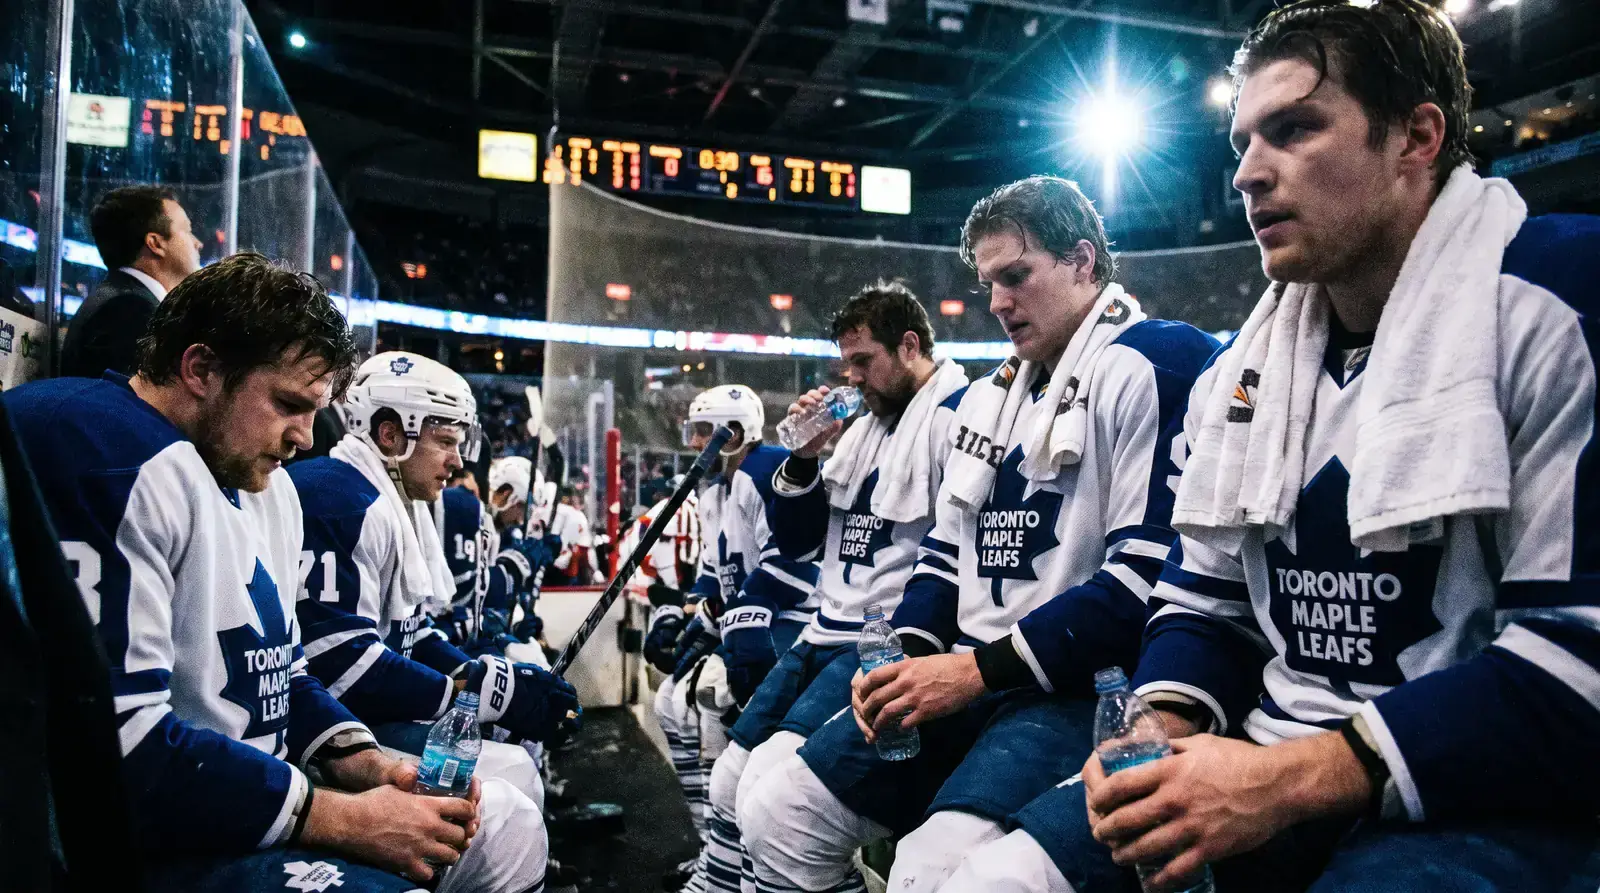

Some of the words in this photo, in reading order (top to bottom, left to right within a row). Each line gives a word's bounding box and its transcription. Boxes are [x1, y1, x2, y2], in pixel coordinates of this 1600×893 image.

[979, 510, 1040, 529] TORONTO
[454, 533, 476, 563] 19
[843, 528, 872, 544] MAPLE
[982, 530, 1025, 548] MAPLE
[841, 541, 867, 558] LEAFS
[982, 550, 1020, 567] LEAFS
[296, 550, 340, 603] 71
[1276, 568, 1402, 602] TORONTO
[1292, 600, 1377, 634] MAPLE
[1298, 631, 1374, 666] LEAFS
